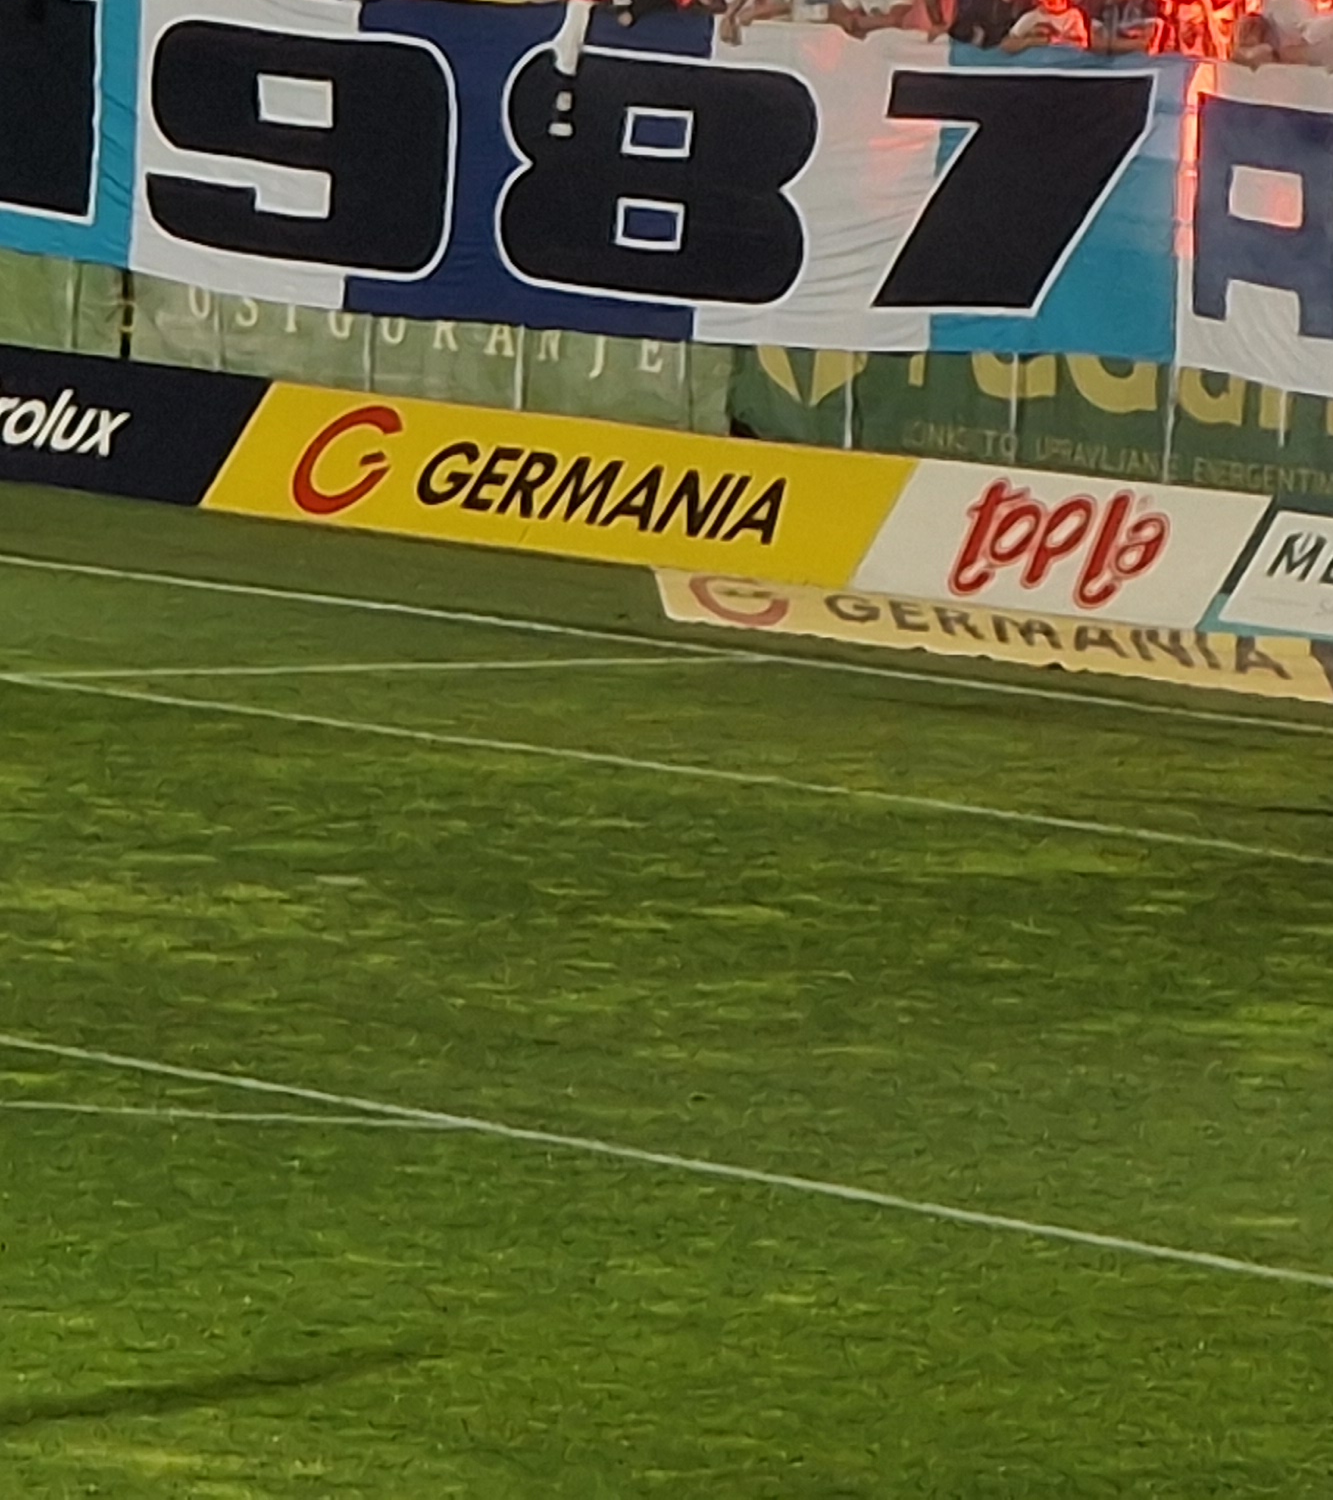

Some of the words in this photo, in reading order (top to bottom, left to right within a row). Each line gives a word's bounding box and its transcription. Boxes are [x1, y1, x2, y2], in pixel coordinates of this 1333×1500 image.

[416, 441, 787, 546] GERMANIA
[948, 477, 1169, 610] topla
[825, 593, 1292, 680] GERMANIA
